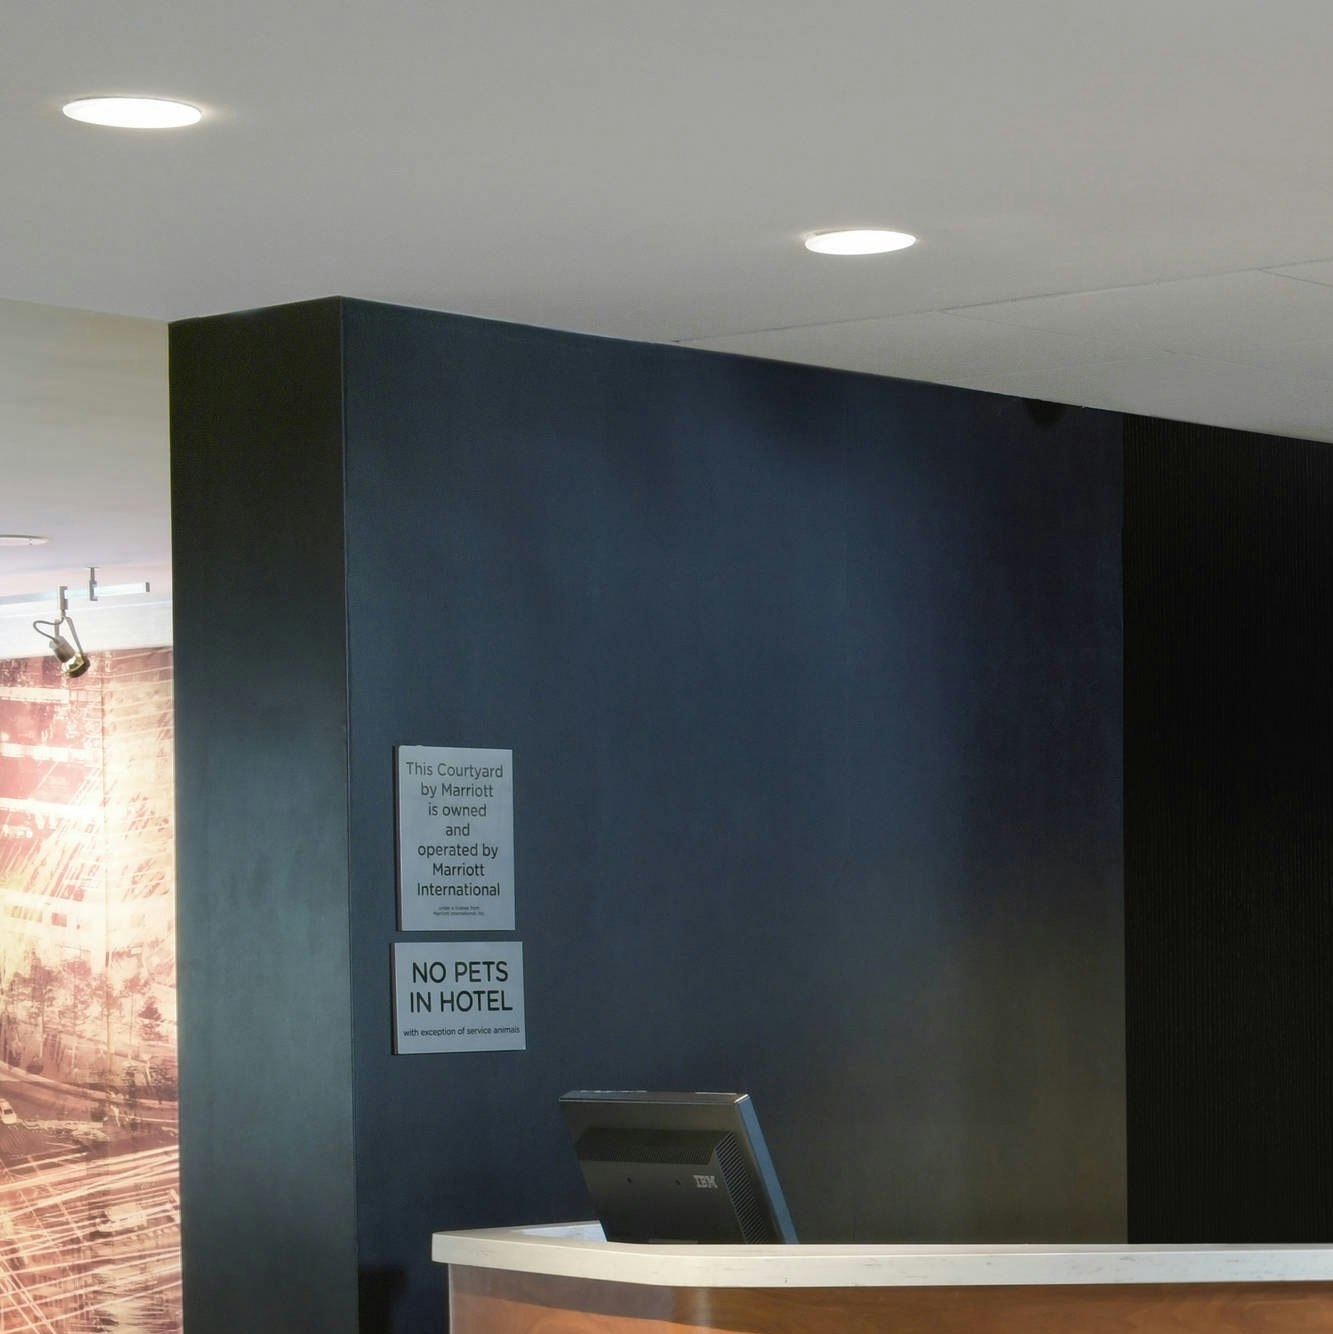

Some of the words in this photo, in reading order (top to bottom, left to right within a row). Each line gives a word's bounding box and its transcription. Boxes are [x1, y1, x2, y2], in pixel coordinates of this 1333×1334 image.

[406, 762, 433, 776] This
[437, 763, 503, 780] Courtyard
[421, 782, 437, 799] by
[442, 783, 493, 798] Marriott
[429, 802, 438, 816] is
[442, 804, 487, 817] owned
[445, 823, 470, 837] and
[417, 843, 478, 858] operated
[482, 843, 498, 859] by
[433, 862, 485, 877] Marriott
[417, 882, 501, 897] International
[412, 961, 446, 984] NO
[455, 961, 508, 983] PETS
[410, 991, 431, 1013] IN
[440, 990, 513, 1013] HOTEL
[403, 1027, 419, 1037] with
[420, 1026, 456, 1038] exception
[457, 1027, 465, 1036] of
[466, 1025, 492, 1036] service
[493, 1024, 520, 1035] animals
[692, 1174, 718, 1189] IBM
